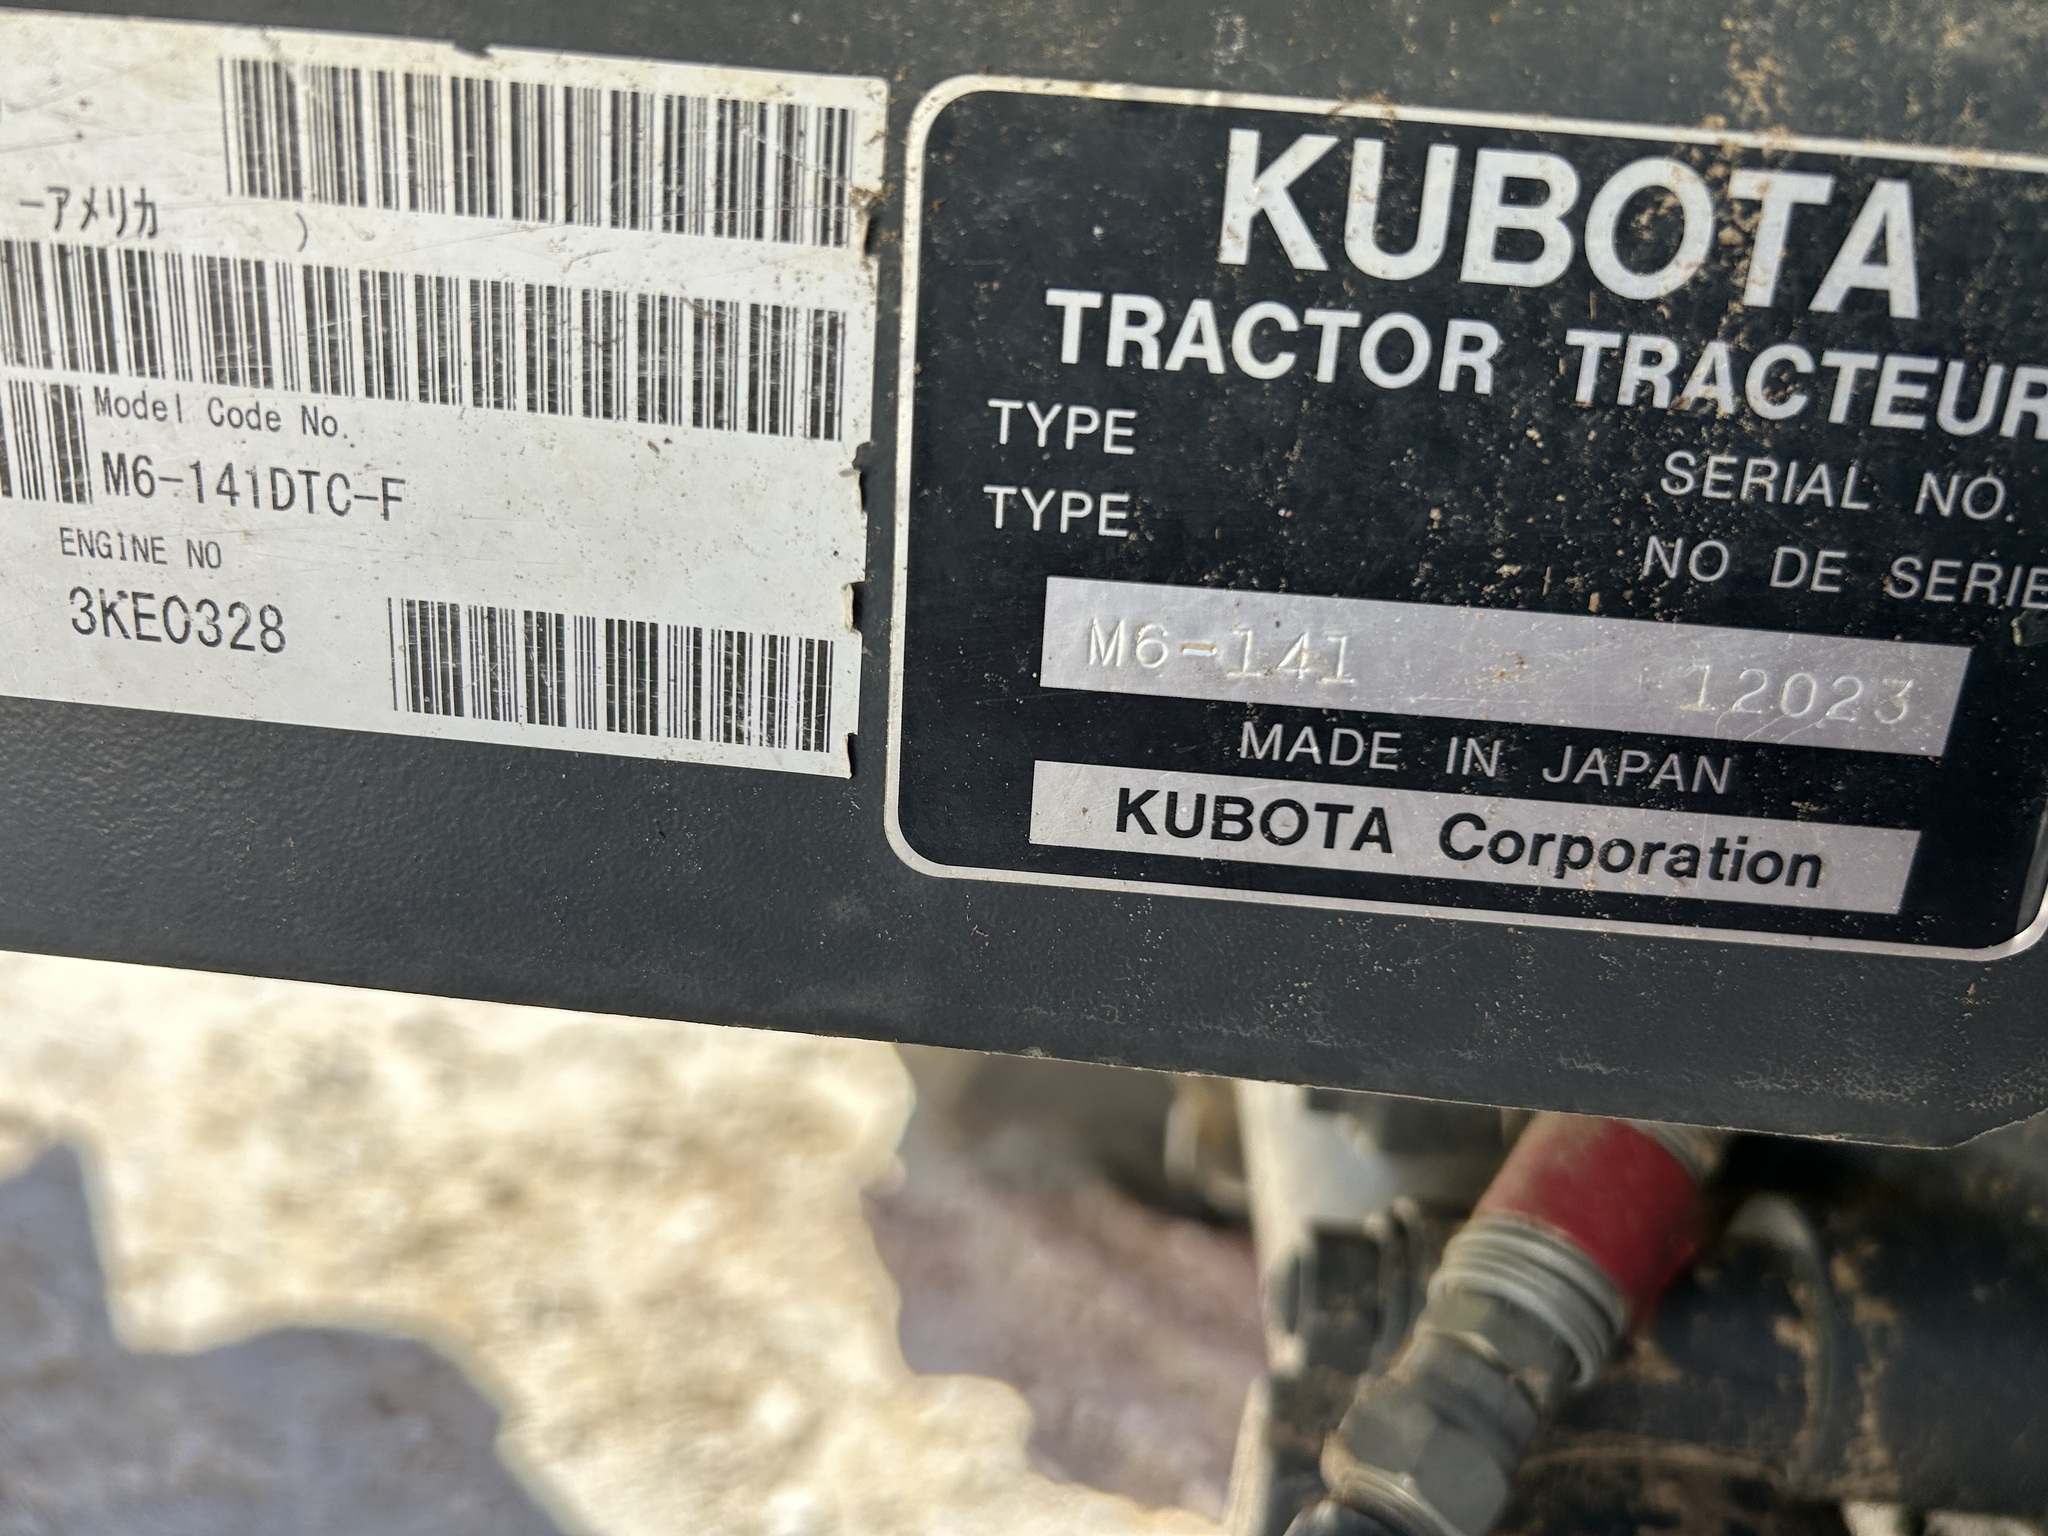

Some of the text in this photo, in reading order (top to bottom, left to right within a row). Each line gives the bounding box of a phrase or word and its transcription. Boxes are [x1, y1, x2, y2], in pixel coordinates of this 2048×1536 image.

[1217, 128, 1920, 319] KUBOTA
[1045, 288, 2048, 440] TRACTOR TRACTEUR
[93, 385, 349, 439] Model Code No.
[988, 398, 1138, 456] TYPE
[102, 451, 407, 522] M6-141DTC-F
[983, 484, 1130, 538] TYPE
[1659, 449, 2015, 524] SERIAL NO.
[59, 527, 223, 570] ENGINE NO
[1641, 534, 2048, 610] NO DE SERIE
[69, 586, 287, 654] 3KE0328
[1088, 617, 1915, 725] M6-141 12023
[1239, 721, 1731, 795] MADE IN JAPAN
[1116, 787, 1823, 888] KUBOTA Corporation
